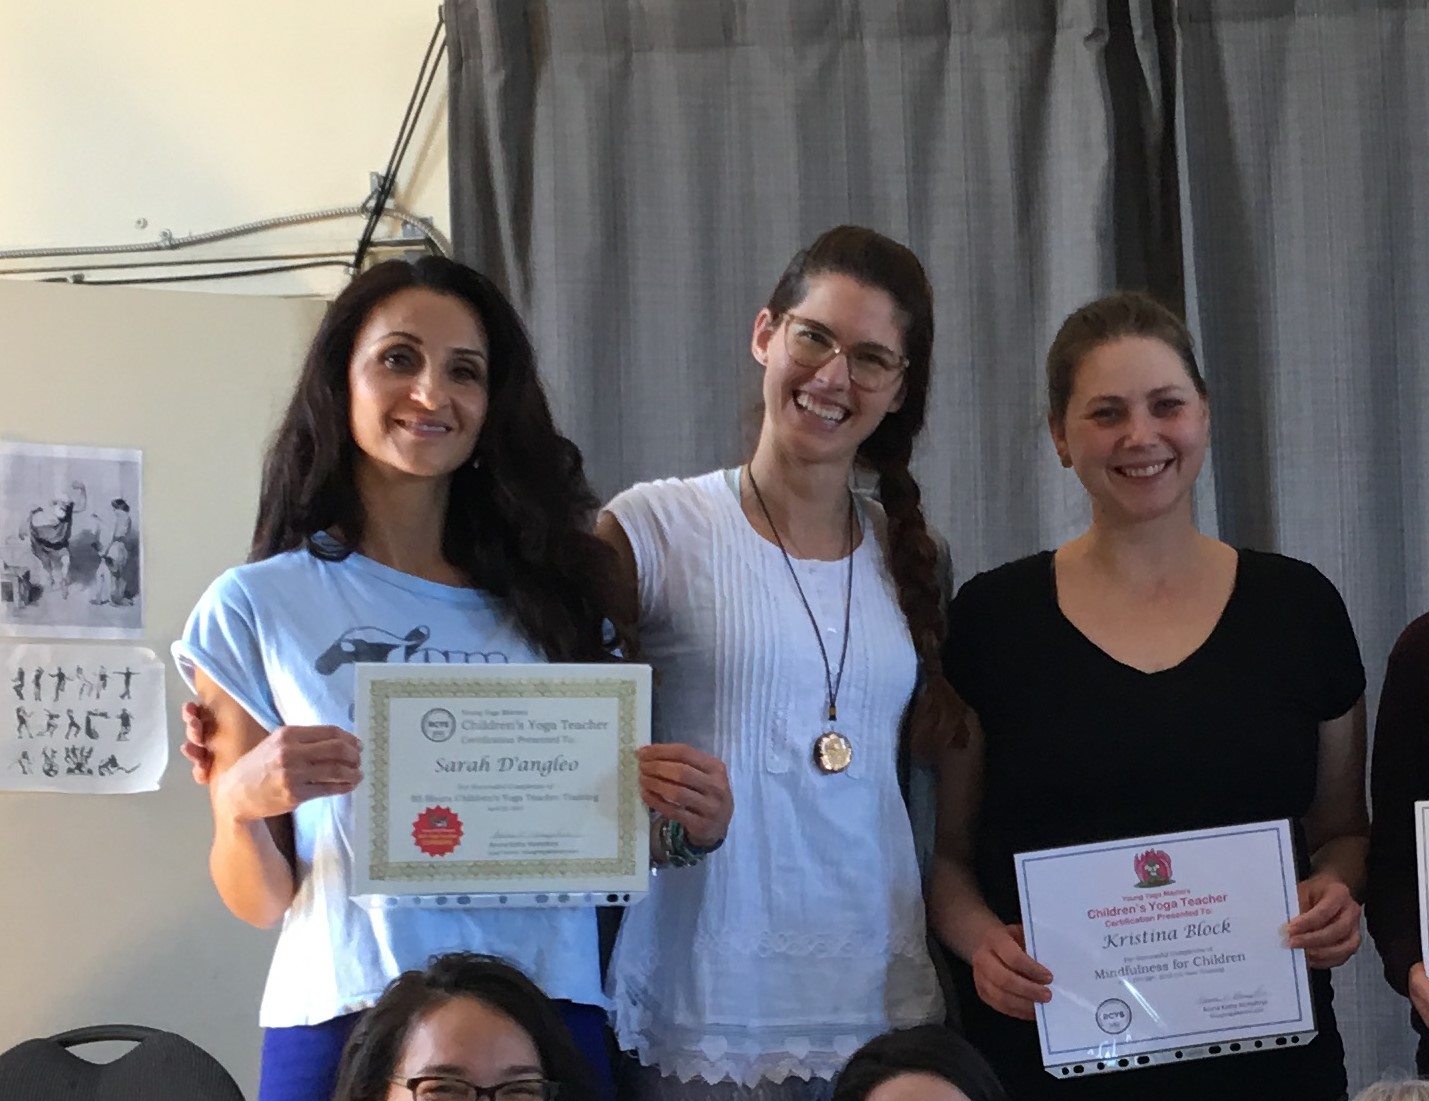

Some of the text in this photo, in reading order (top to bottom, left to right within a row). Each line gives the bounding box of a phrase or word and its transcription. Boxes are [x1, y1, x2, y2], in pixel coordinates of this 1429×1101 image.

[461, 719, 608, 733] Children's Yoga Teacher
[435, 754, 579, 777] Sarah D'angleo
[1087, 894, 1228, 920] Children's Yoga Teacher
[1104, 916, 1155, 928] Certification
[1157, 909, 1199, 921] Presented
[1102, 919, 1231, 949] Kristina Block
[1094, 963, 1169, 980] Mindfulness
[1172, 959, 1189, 970] for
[1192, 953, 1246, 967] Children
